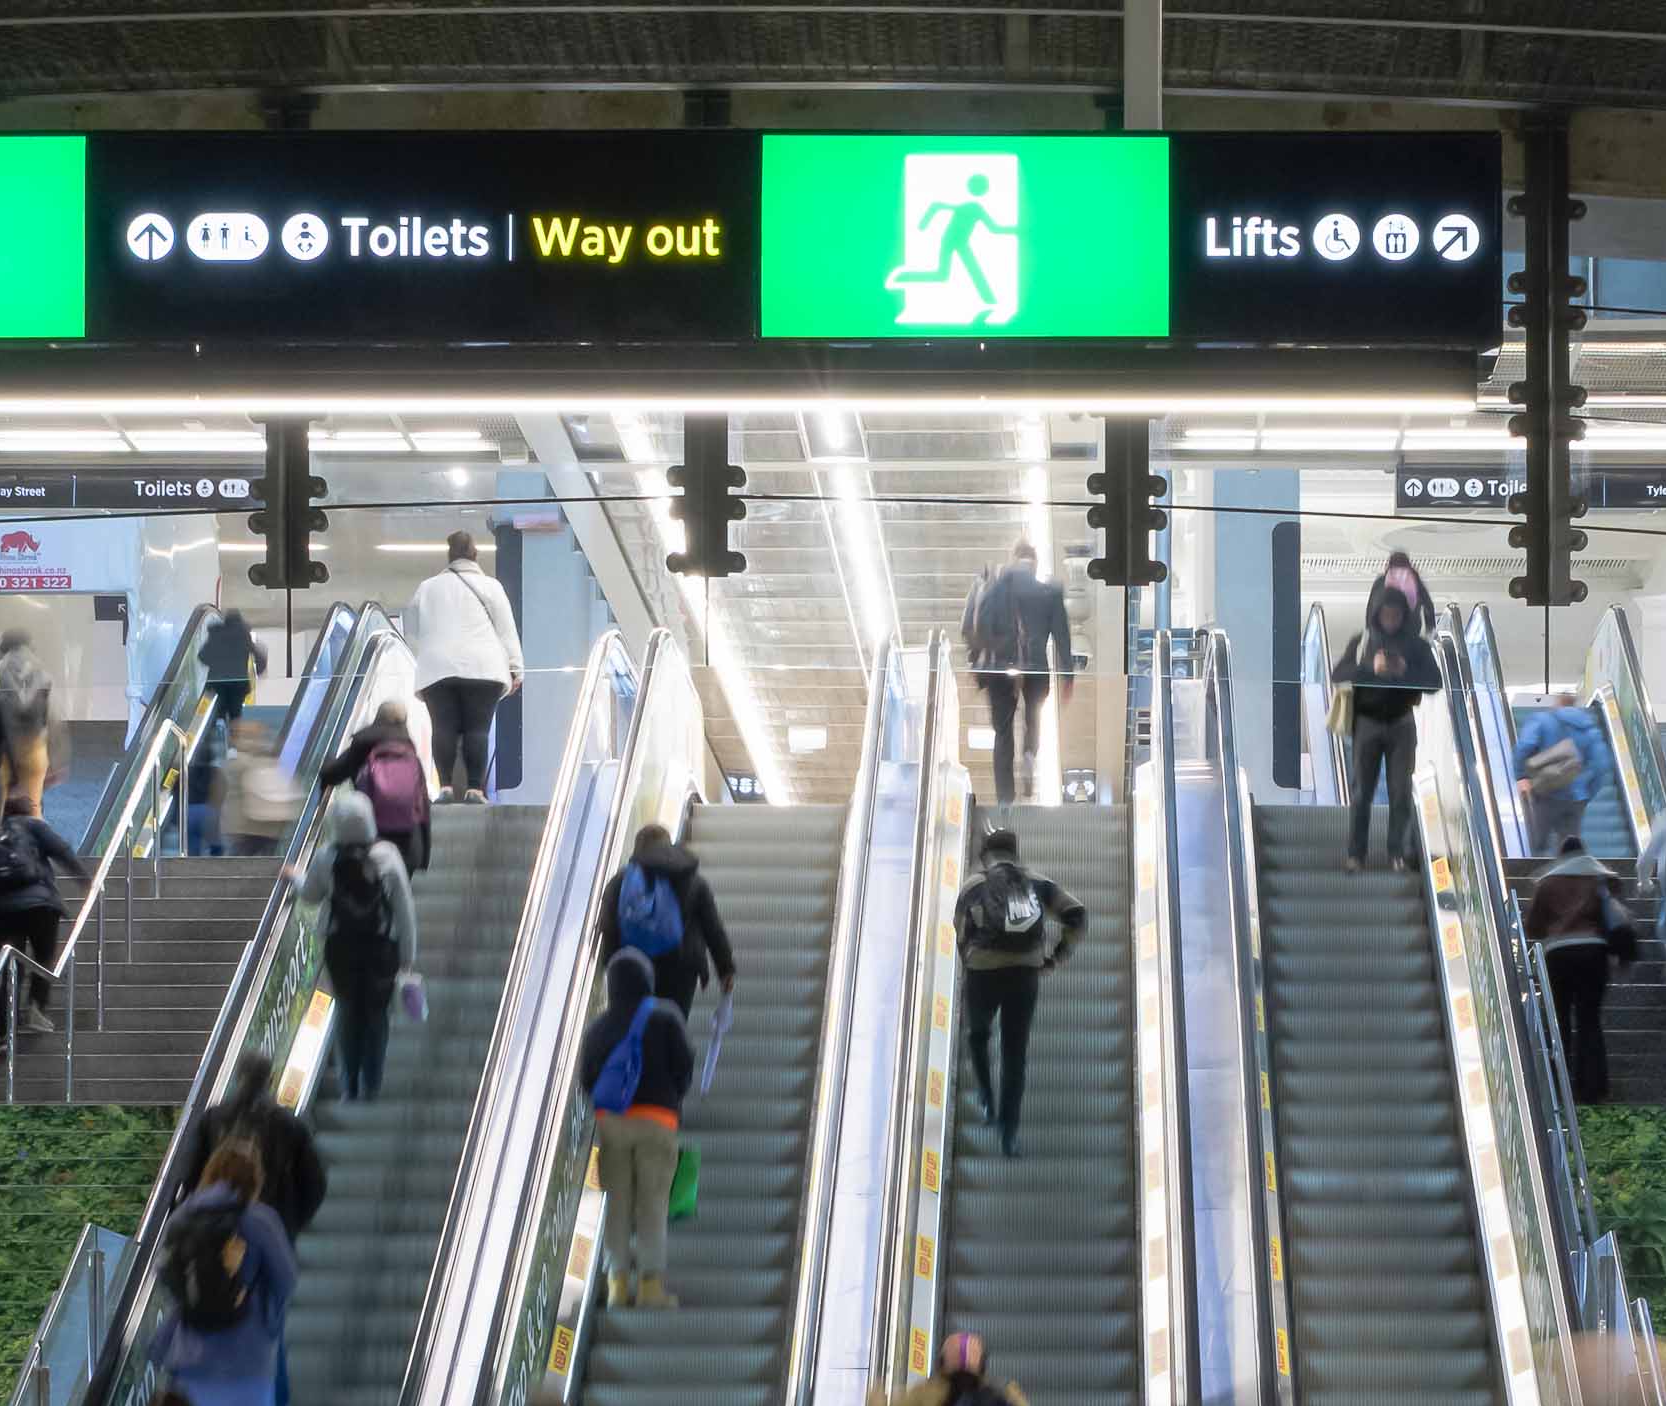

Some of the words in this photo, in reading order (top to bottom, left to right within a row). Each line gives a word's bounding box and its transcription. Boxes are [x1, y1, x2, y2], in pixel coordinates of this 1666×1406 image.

[341, 217, 489, 257] Toilets
[533, 218, 632, 263] Way
[647, 219, 720, 256] out
[1206, 216, 1300, 258] Lifts
[12, 485, 45, 497] Street
[134, 480, 191, 497] Toilets
[1487, 479, 1528, 497] Toile
[11, 577, 37, 588] 321
[42, 577, 68, 588] 322
[559, 1329, 573, 1351] LEFT
[555, 1350, 570, 1370] KEEP
